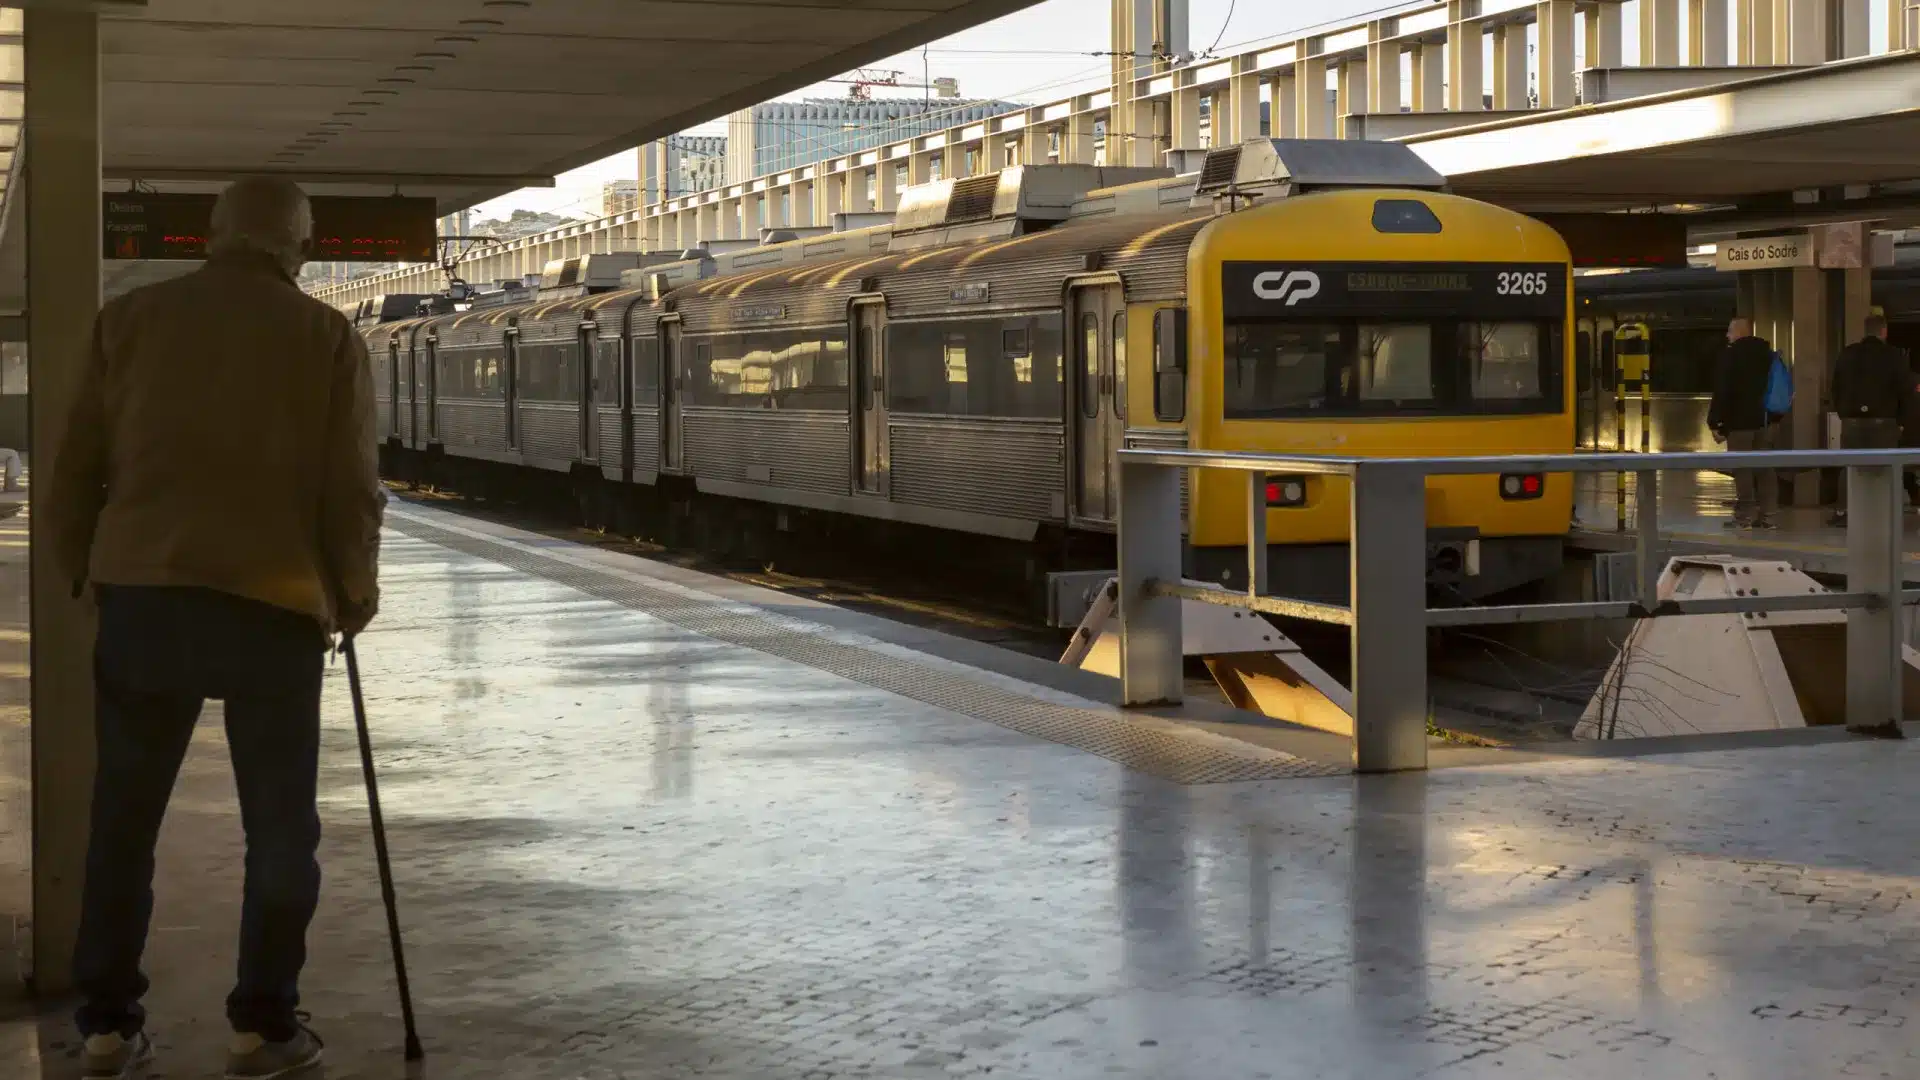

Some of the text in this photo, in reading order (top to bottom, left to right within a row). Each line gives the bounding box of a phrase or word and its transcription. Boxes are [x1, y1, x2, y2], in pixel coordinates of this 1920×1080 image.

[1727, 242, 1798, 261] Cais do Sodré
[1496, 272, 1548, 294] 3265
